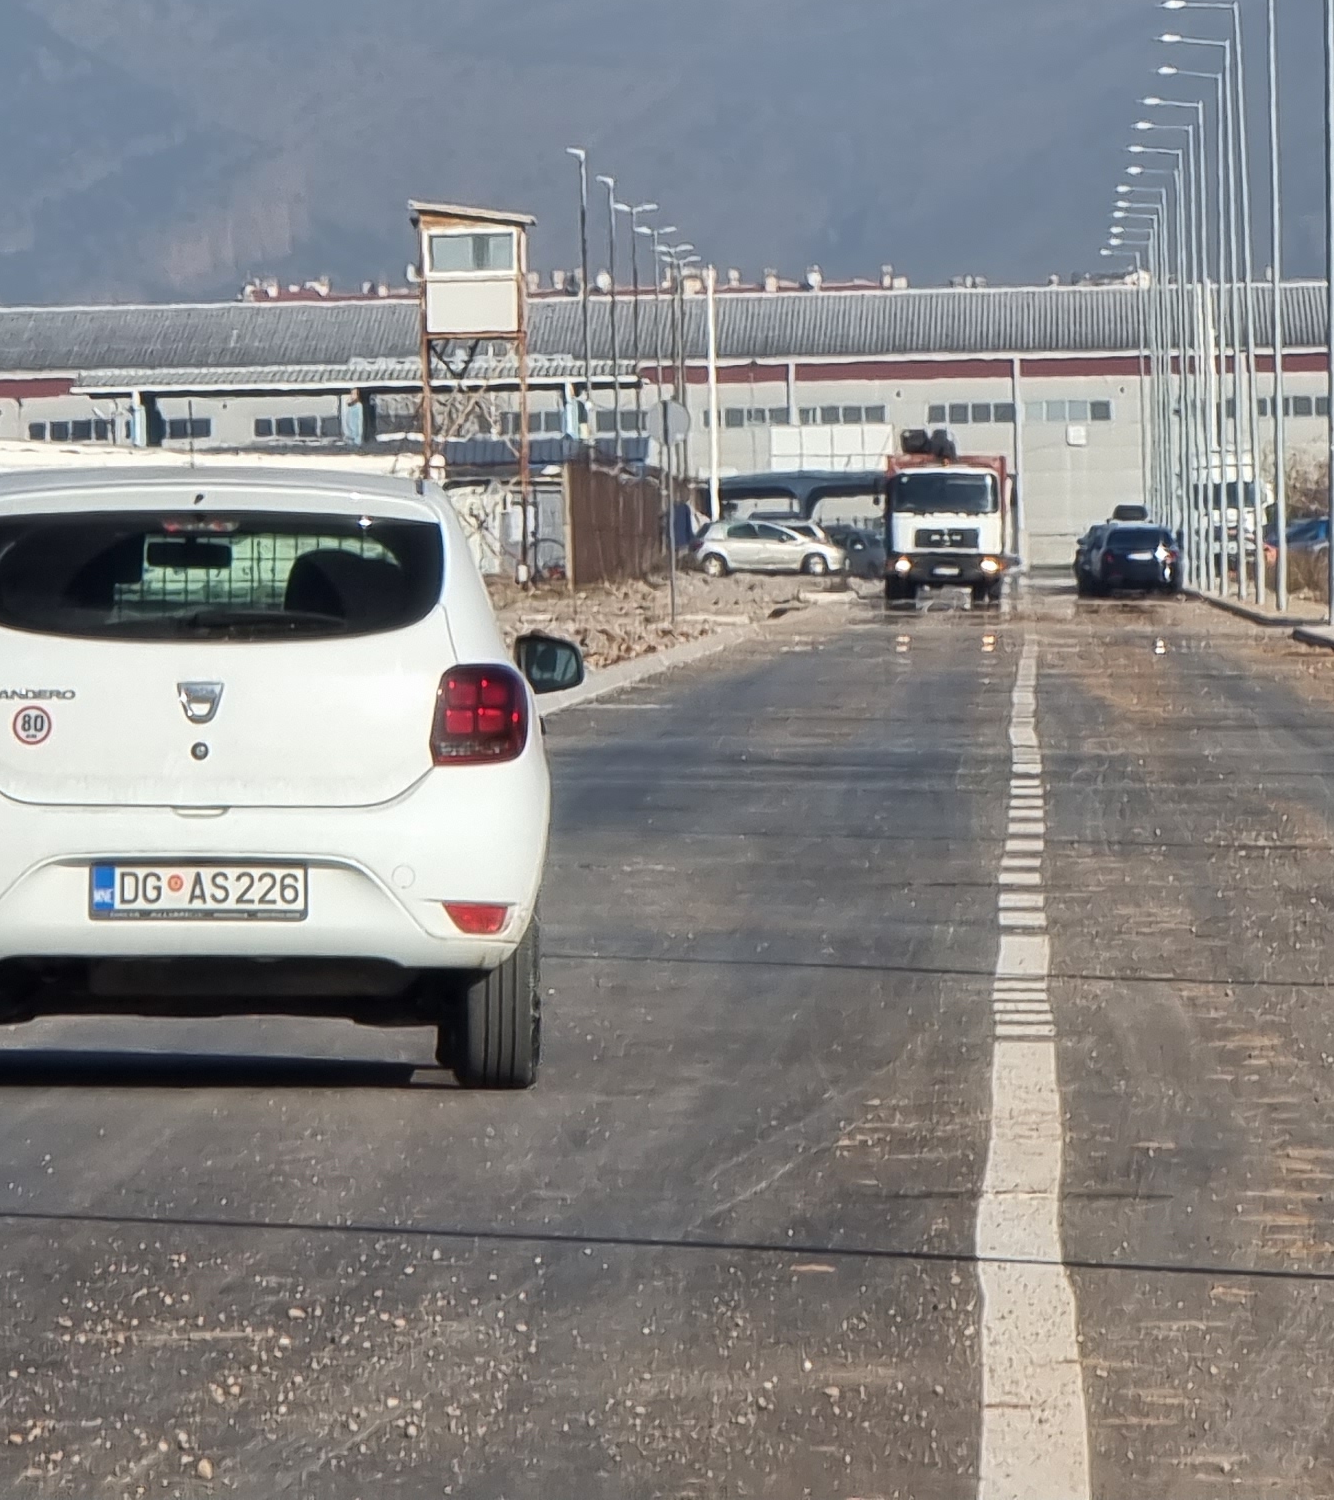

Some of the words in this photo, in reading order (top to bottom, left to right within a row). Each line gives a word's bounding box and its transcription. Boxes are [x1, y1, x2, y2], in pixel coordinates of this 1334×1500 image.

[21, 713, 44, 732] 80
[120, 871, 162, 905] DG
[188, 871, 299, 905] AS226
